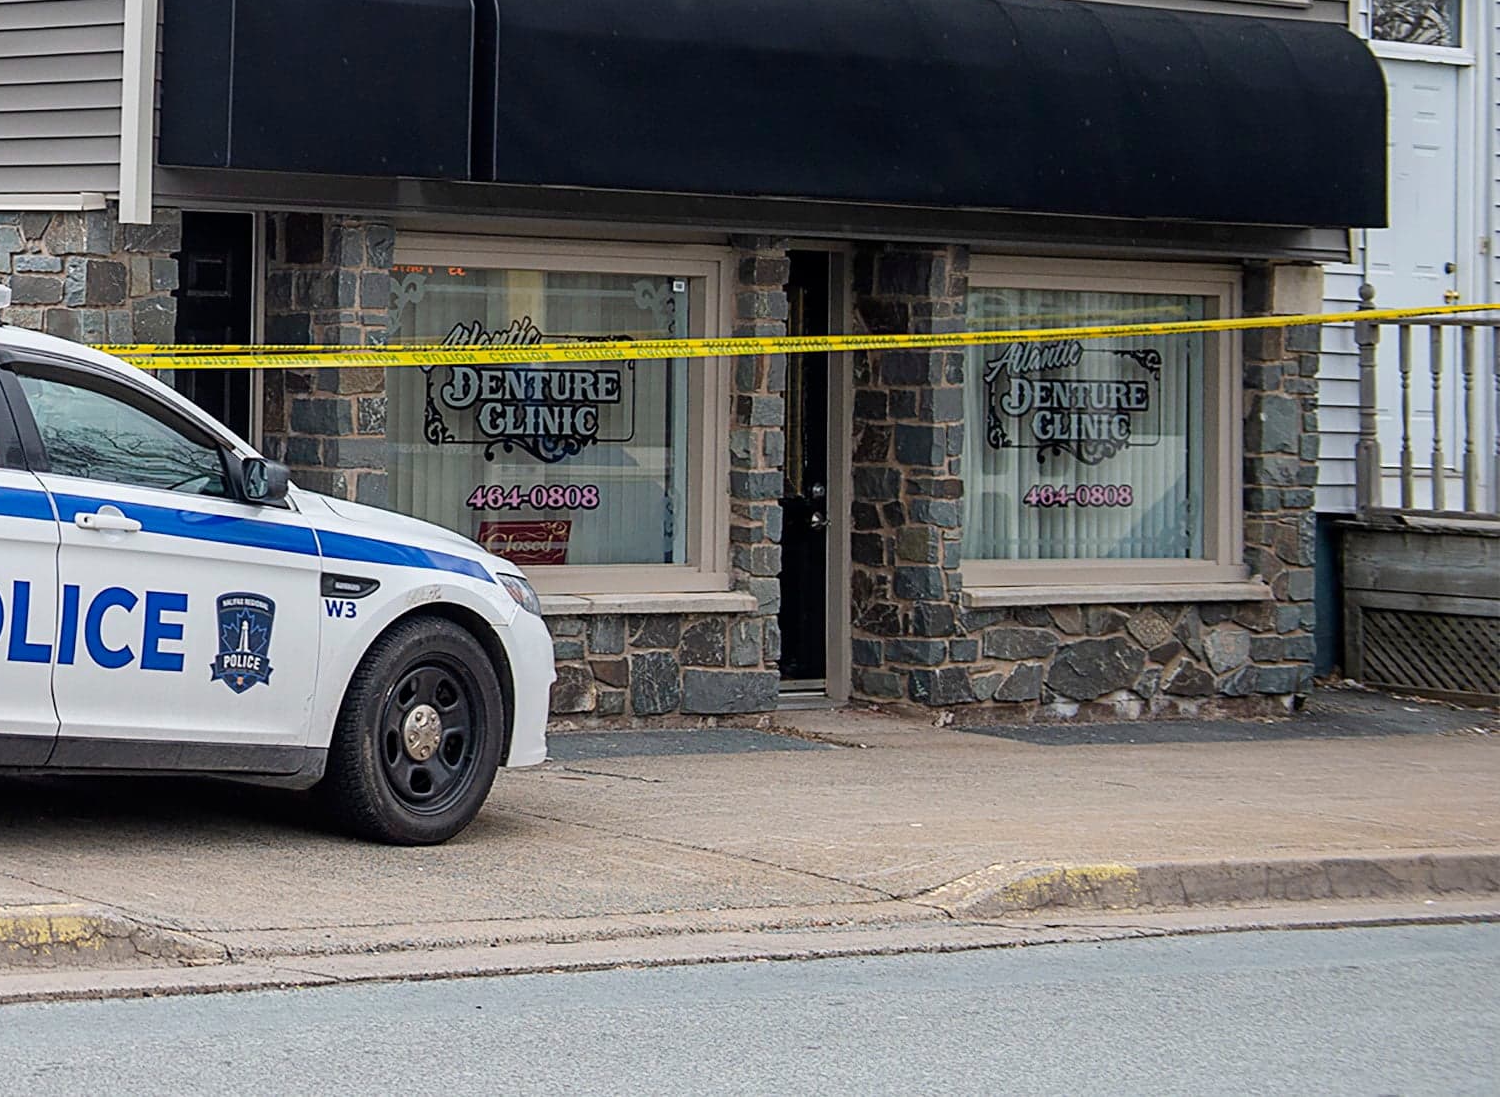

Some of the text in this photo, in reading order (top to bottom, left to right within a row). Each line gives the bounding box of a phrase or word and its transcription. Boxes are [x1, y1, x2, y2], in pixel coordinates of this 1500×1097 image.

[984, 340, 1083, 382] Atlantic
[441, 366, 620, 410] DENTURE
[1001, 377, 1148, 416] DENTURE
[476, 402, 599, 438] CLINIC
[1031, 410, 1132, 441] CLINIC
[466, 485, 600, 510] 464-0808
[1023, 484, 1134, 508] 464-0808
[486, 533, 553, 555] Closed
[325, 599, 357, 618] W3
[223, 654, 261, 671] POLICE
